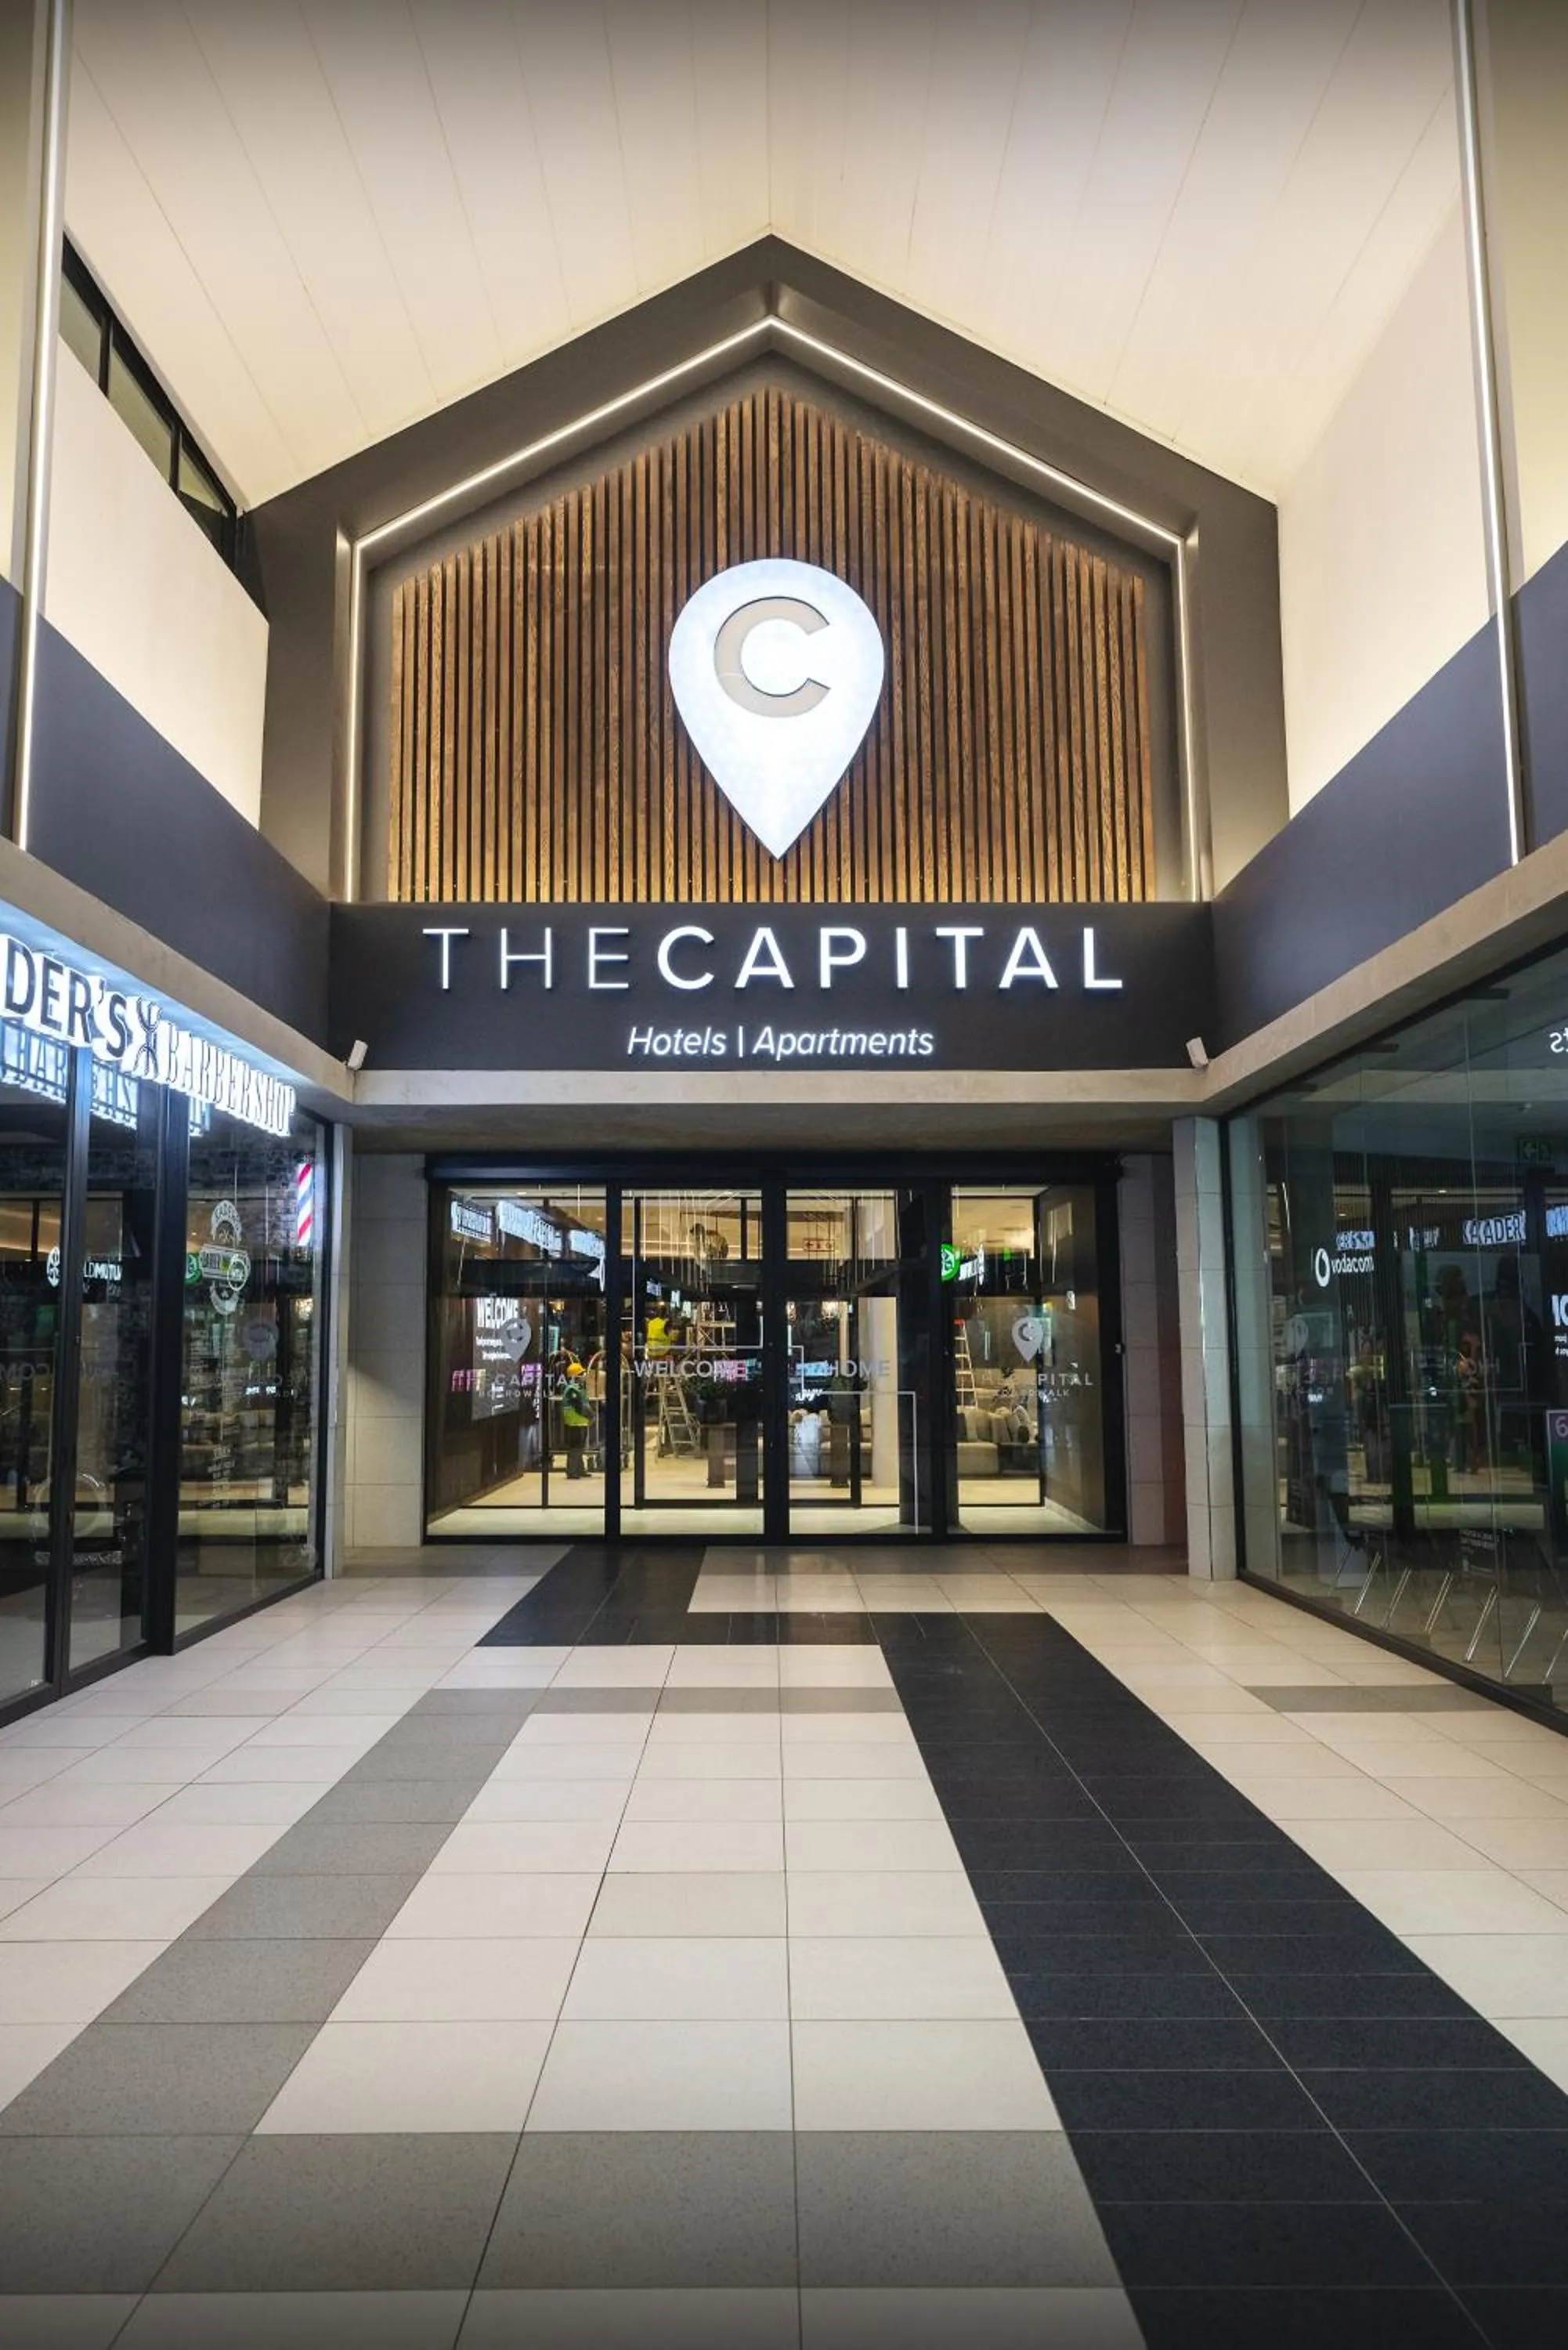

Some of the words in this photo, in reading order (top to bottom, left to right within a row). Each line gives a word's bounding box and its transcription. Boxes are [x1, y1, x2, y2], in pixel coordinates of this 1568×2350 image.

[627, 1026, 727, 1055] Hotels
[752, 1026, 934, 1061] Apartments
[160, 1021, 296, 1137] BARBERSHOP
[1331, 1253, 1375, 1274] vodacom
[634, 1360, 747, 1378] WELCOME
